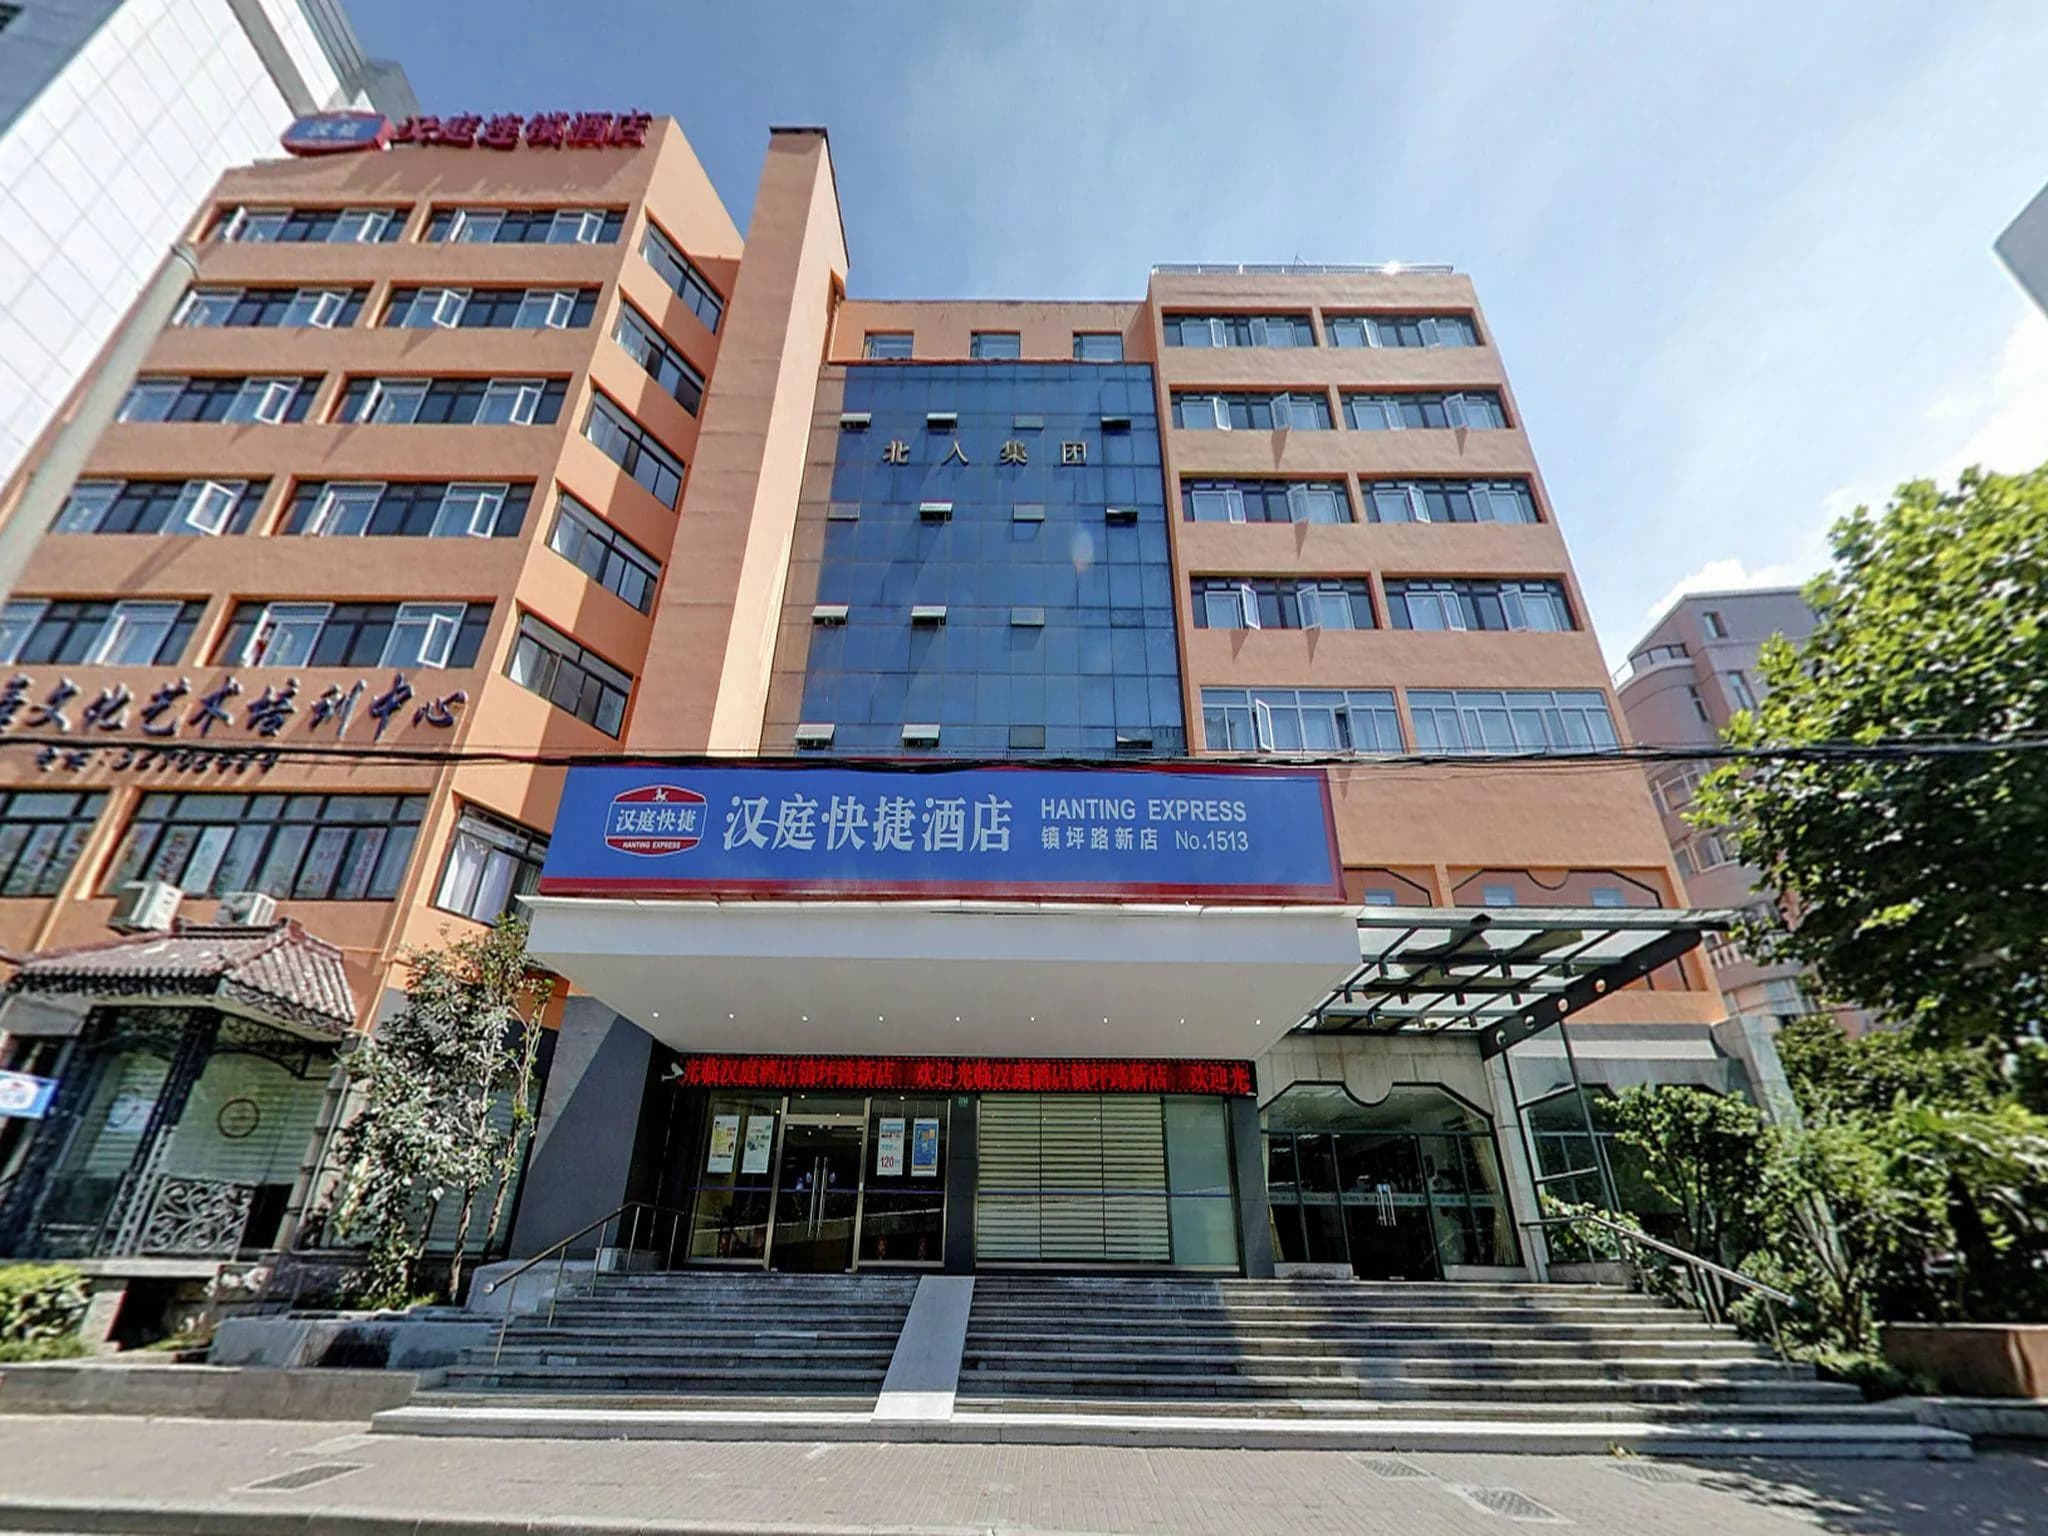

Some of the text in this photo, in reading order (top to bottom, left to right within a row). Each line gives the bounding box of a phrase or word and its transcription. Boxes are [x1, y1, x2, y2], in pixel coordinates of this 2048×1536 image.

[882, 440, 1087, 465] 北人集团
[616, 808, 697, 832] 汉庭快捷
[1041, 798, 1248, 822] HANTING EXPRESS
[722, 792, 1013, 853] 汉庭快捷酒店
[622, 841, 681, 850] HANTING EXPRESS
[1041, 826, 1249, 852] 镇坪路新店 No.1513
